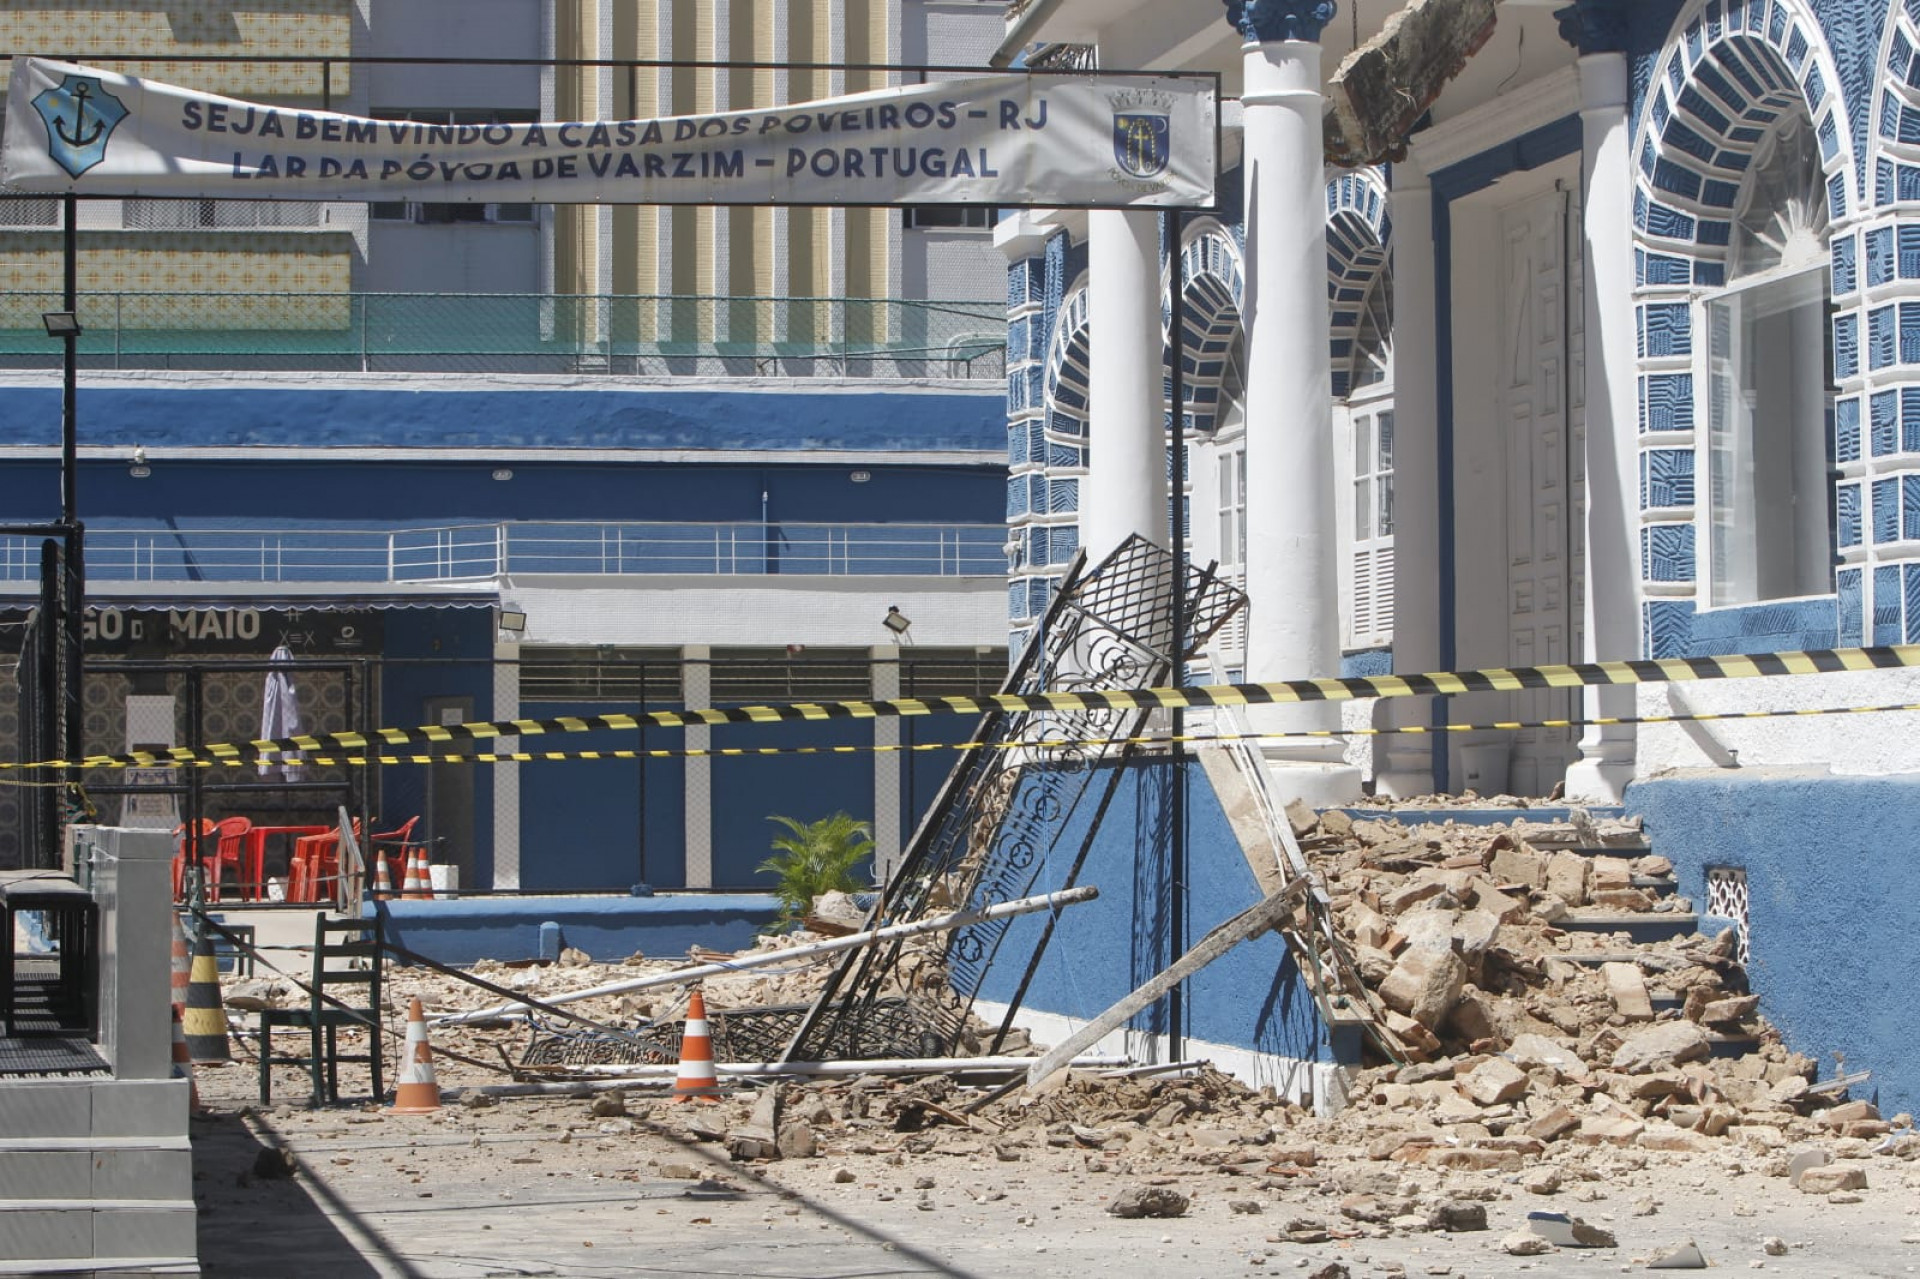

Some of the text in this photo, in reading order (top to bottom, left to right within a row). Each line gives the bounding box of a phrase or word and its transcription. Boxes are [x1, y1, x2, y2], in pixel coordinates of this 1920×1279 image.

[182, 101, 284, 138] SEJA
[296, 112, 378, 144] BEM
[388, 121, 514, 146] VINDO
[521, 122, 548, 147] A
[558, 119, 663, 148] CASA
[674, 117, 751, 142] DOS
[758, 101, 957, 135] POVEIROS
[1000, 99, 1048, 130] RJ
[232, 151, 307, 179] LAR
[318, 156, 369, 180] DA
[380, 152, 522, 182] PÓVOA
[532, 155, 578, 179] DE
[587, 150, 744, 179] VARZIM
[786, 147, 998, 178] PORTUGAL
[169, 608, 261, 640] MAIO
